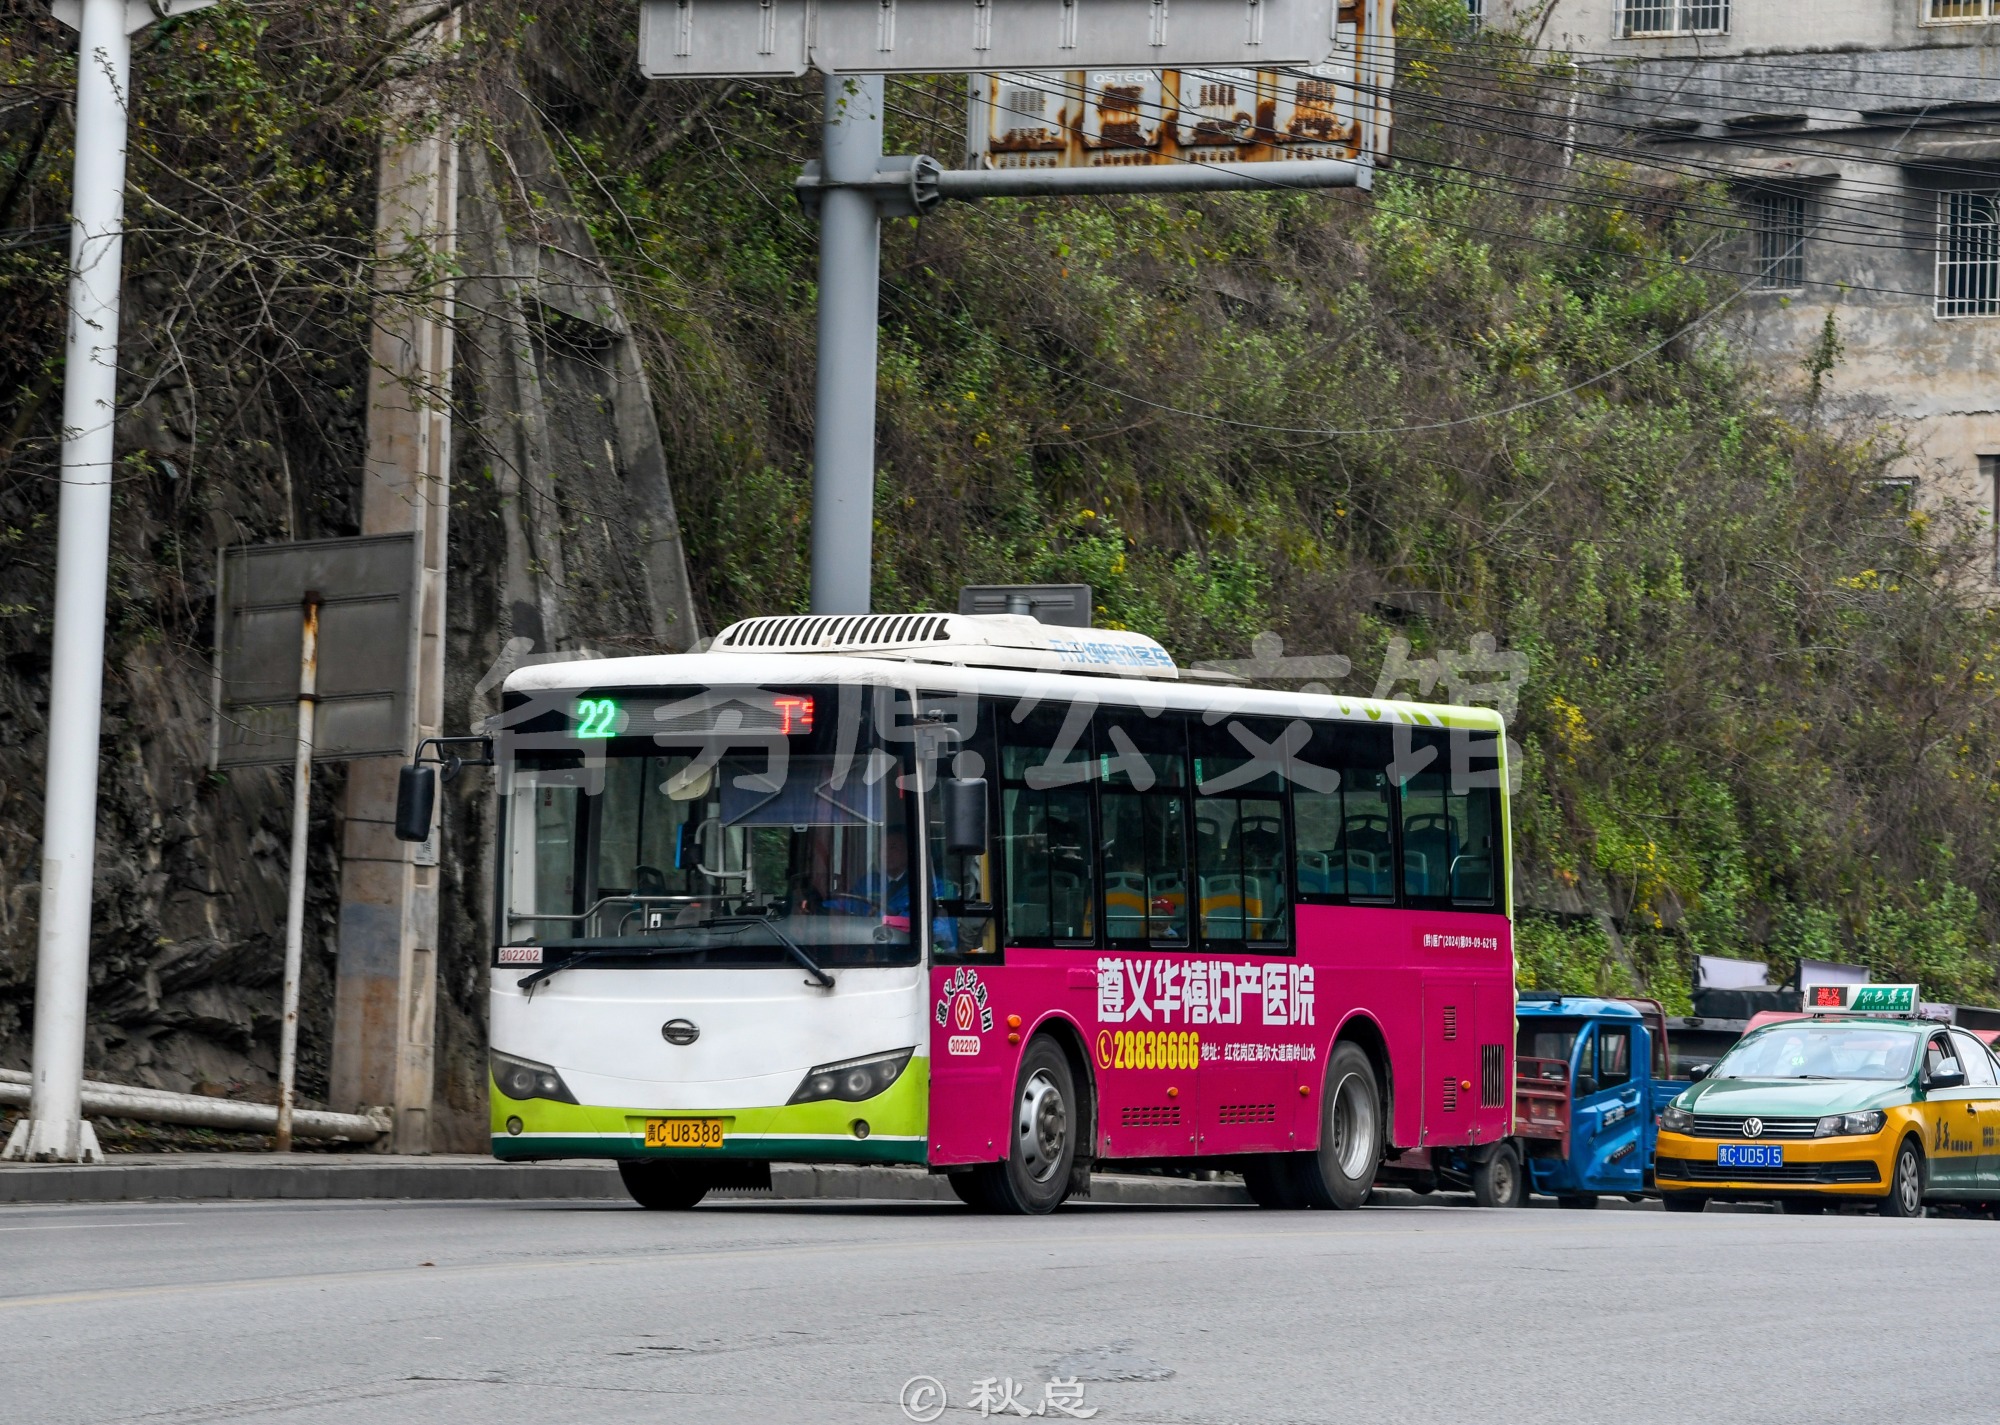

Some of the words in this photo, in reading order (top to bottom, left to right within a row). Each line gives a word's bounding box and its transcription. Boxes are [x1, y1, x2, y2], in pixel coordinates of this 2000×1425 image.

[577, 698, 616, 739] 22
[500, 949, 540, 962] 302202
[1097, 957, 1315, 1026] 遵义华禧妇产医院
[950, 1039, 978, 1053] 302202
[1114, 1030, 1200, 1070] 28836666
